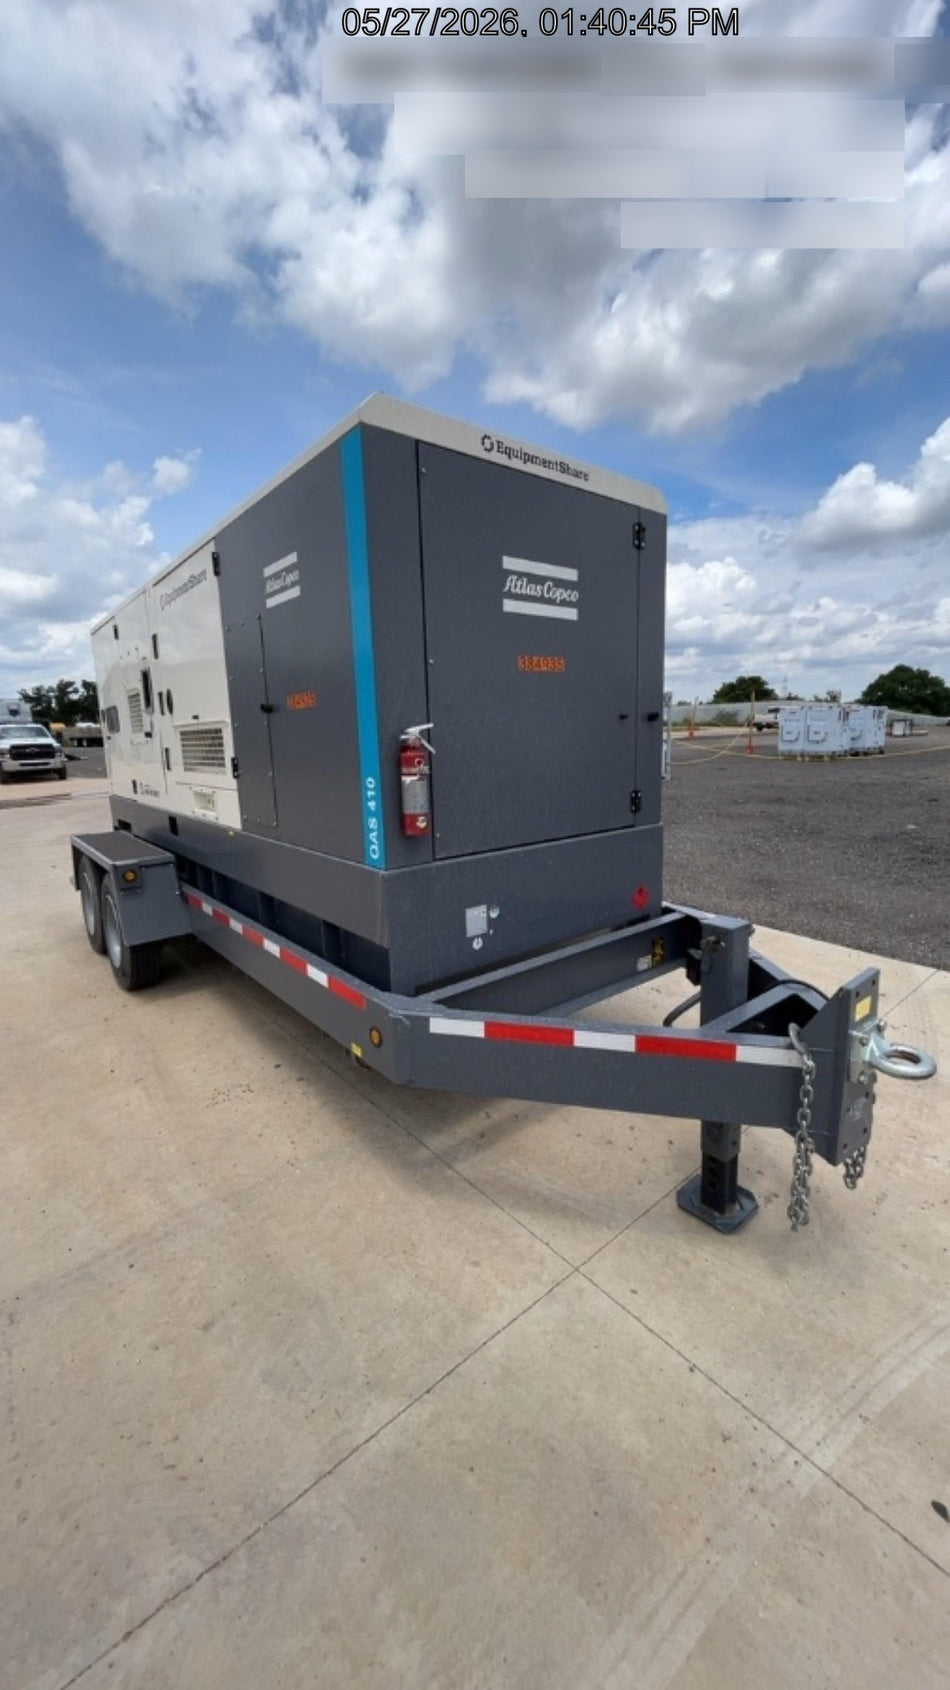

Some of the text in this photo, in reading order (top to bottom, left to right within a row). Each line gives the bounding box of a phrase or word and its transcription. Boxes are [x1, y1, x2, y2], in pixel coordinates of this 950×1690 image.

[496, 439, 590, 482] EquipmentShare
[502, 574, 579, 604] Atlas Copco
[365, 776, 380, 860] QAS 410
